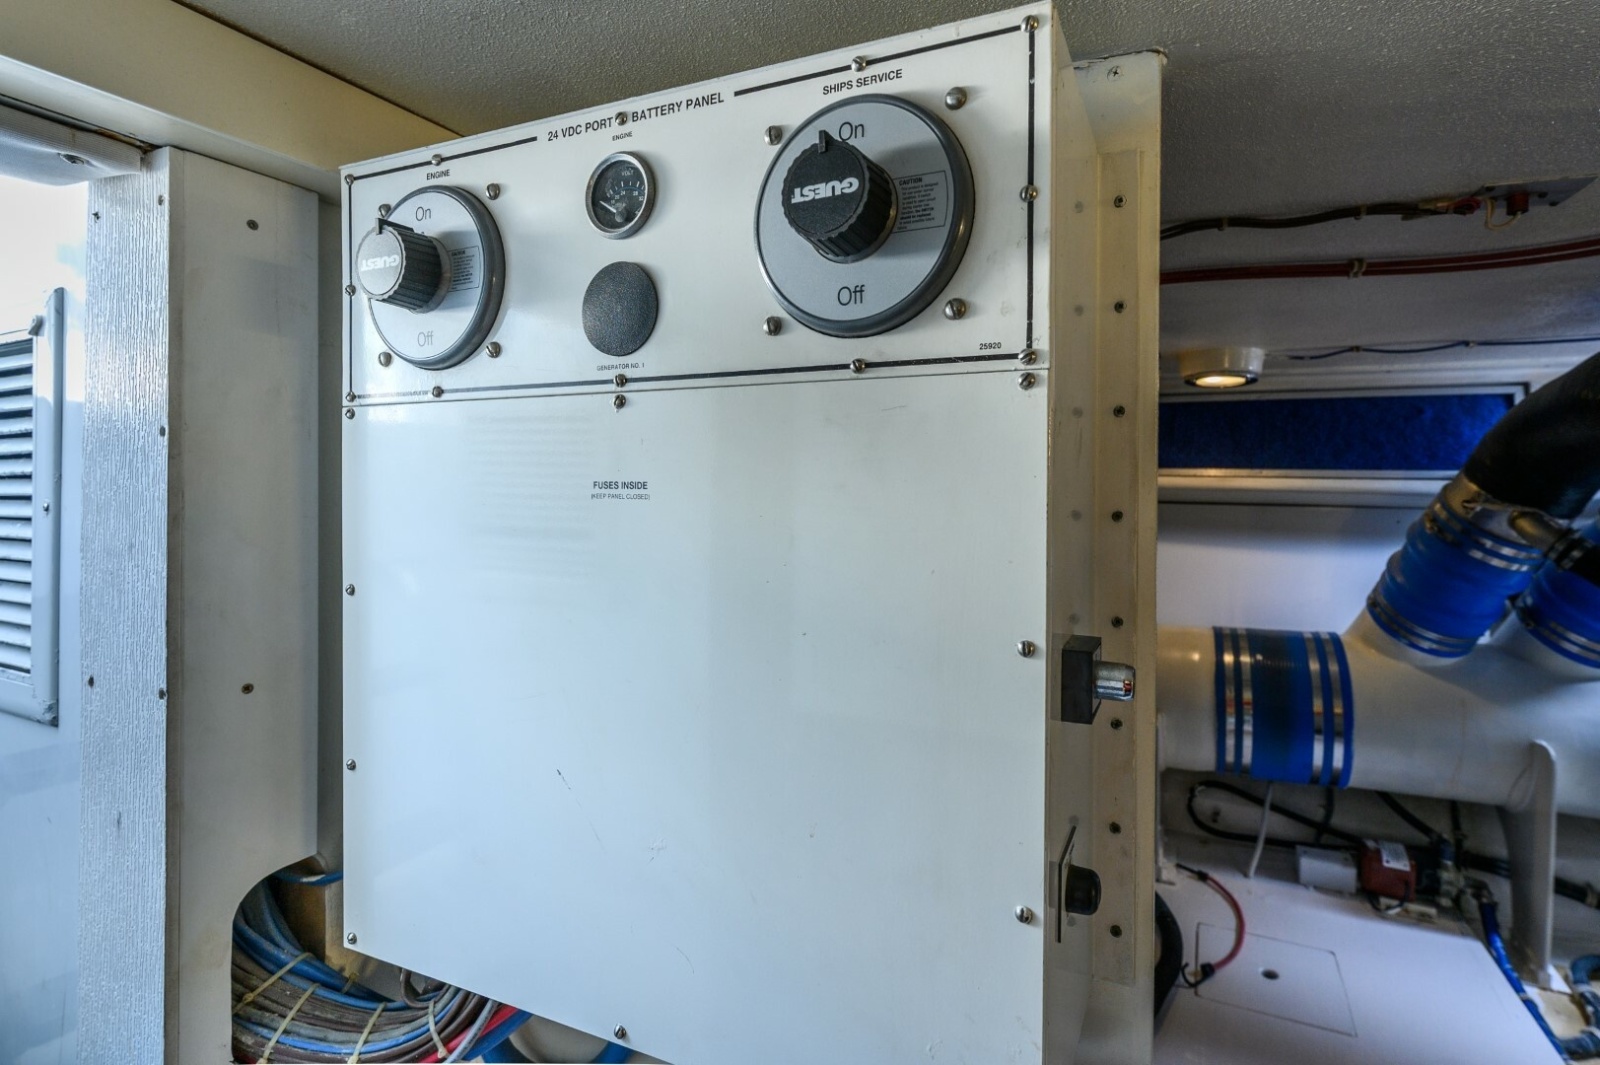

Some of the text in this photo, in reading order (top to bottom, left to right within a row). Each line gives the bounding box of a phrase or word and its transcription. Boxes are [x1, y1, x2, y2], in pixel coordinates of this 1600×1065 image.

[822, 68, 903, 95] SHIPS SERVICE
[547, 92, 725, 142] 24 VDC PORT BATTERY PANEL
[612, 131, 633, 142] ENGINE
[838, 121, 865, 141] On
[426, 169, 450, 181] ENGINE
[899, 177, 923, 186] CAUTION
[791, 176, 859, 204] GUEST
[415, 206, 432, 222] On
[360, 254, 400, 272] GUEST
[837, 284, 865, 306] Off
[416, 331, 434, 347] Off
[979, 341, 1002, 350] 25920
[596, 363, 630, 372] GENERATOR
[593, 480, 649, 490] FUSES INSIDE
[590, 492, 607, 500] (KEEP
[625, 493, 651, 501] CLOSED)
